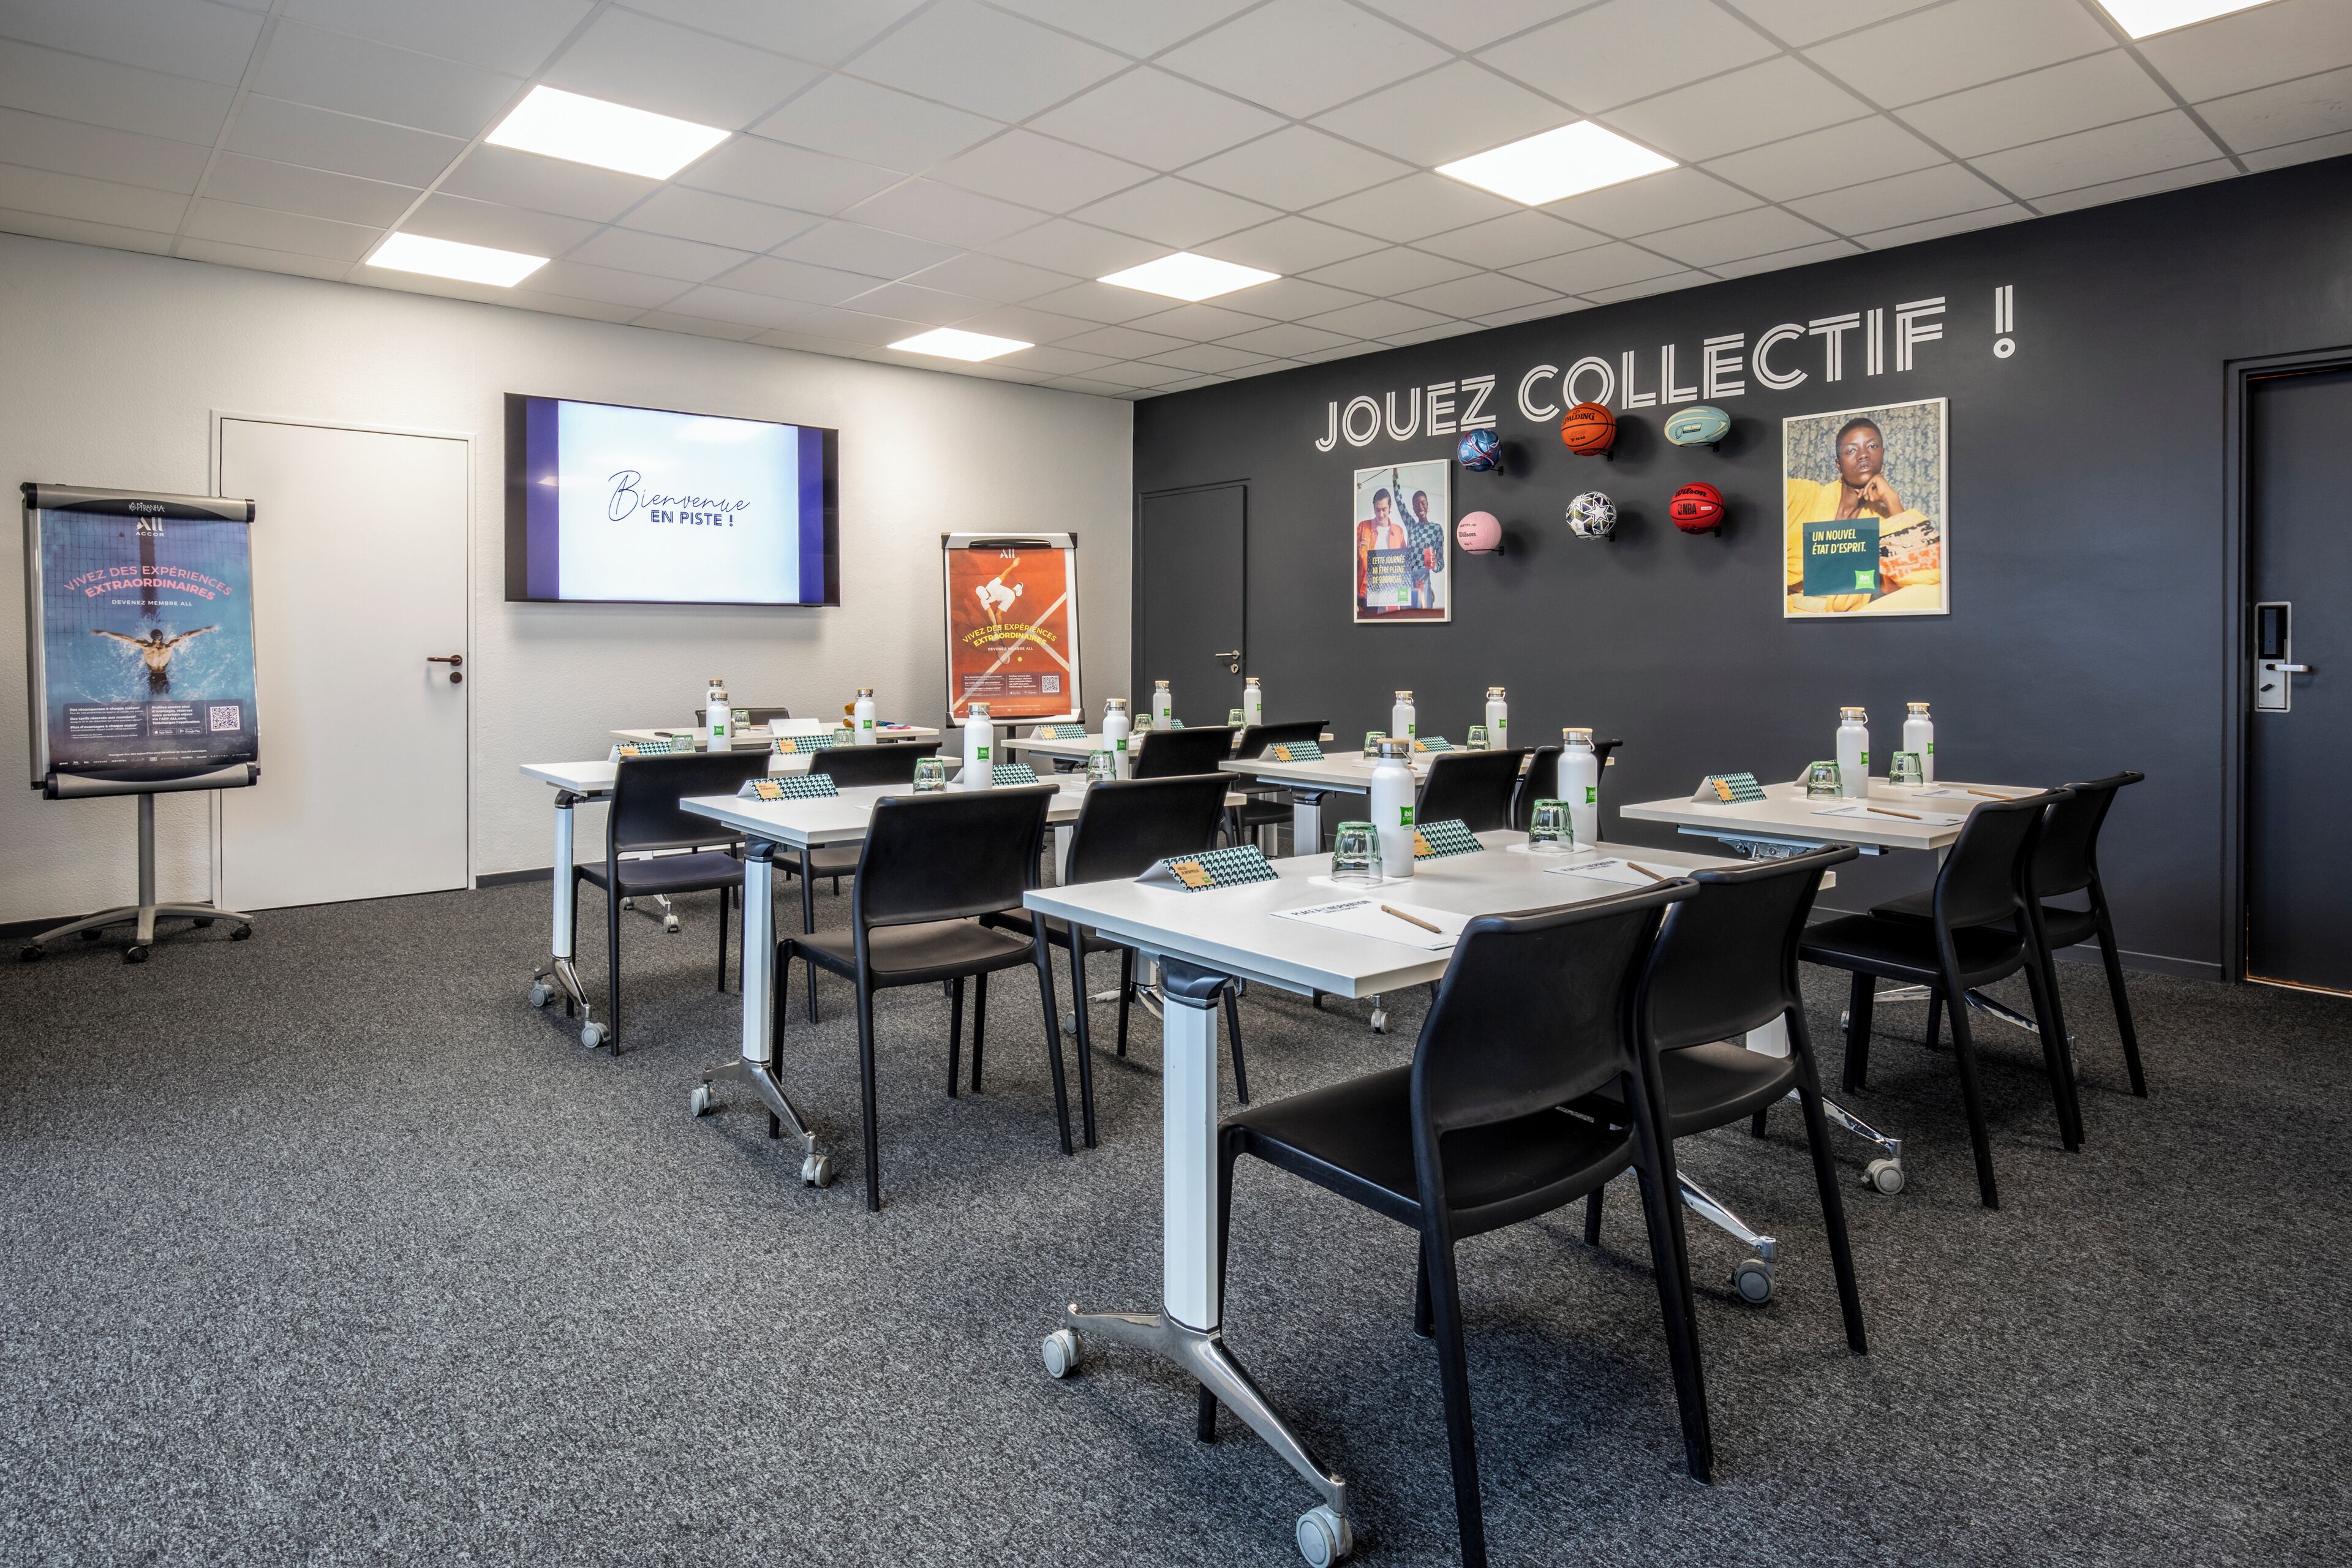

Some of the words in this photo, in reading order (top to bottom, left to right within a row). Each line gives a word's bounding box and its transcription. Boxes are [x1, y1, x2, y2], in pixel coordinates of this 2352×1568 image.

[1315, 374, 1496, 452] JOUEZ
[1518, 296, 1946, 423] COLLECTIF
[1993, 285, 2016, 359] !
[608, 470, 750, 521] Bienvenue
[1683, 503, 1697, 515] NBA
[650, 510, 674, 523] EN
[680, 511, 723, 527] PISTE
[729, 514, 733, 527] !
[1812, 531, 1825, 542] UN
[1826, 529, 1856, 541] NOUVEL
[1812, 542, 1830, 555] ÉTAT
[1831, 541, 1866, 554] D'ESPRIT.
[1385, 554, 1406, 564] JOURNÉE
[64, 570, 107, 592] VIVEZ
[109, 566, 138, 577] DES
[142, 565, 233, 596] EXPÉRIENCES
[84, 578, 216, 601] EXTRAORDINAIRES
[962, 628, 986, 643] VIVEZ
[986, 624, 1002, 633] DES
[1004, 623, 1057, 642] EXPÉRIENCES
[973, 632, 1047, 647] EXTRAORDINAIRES
